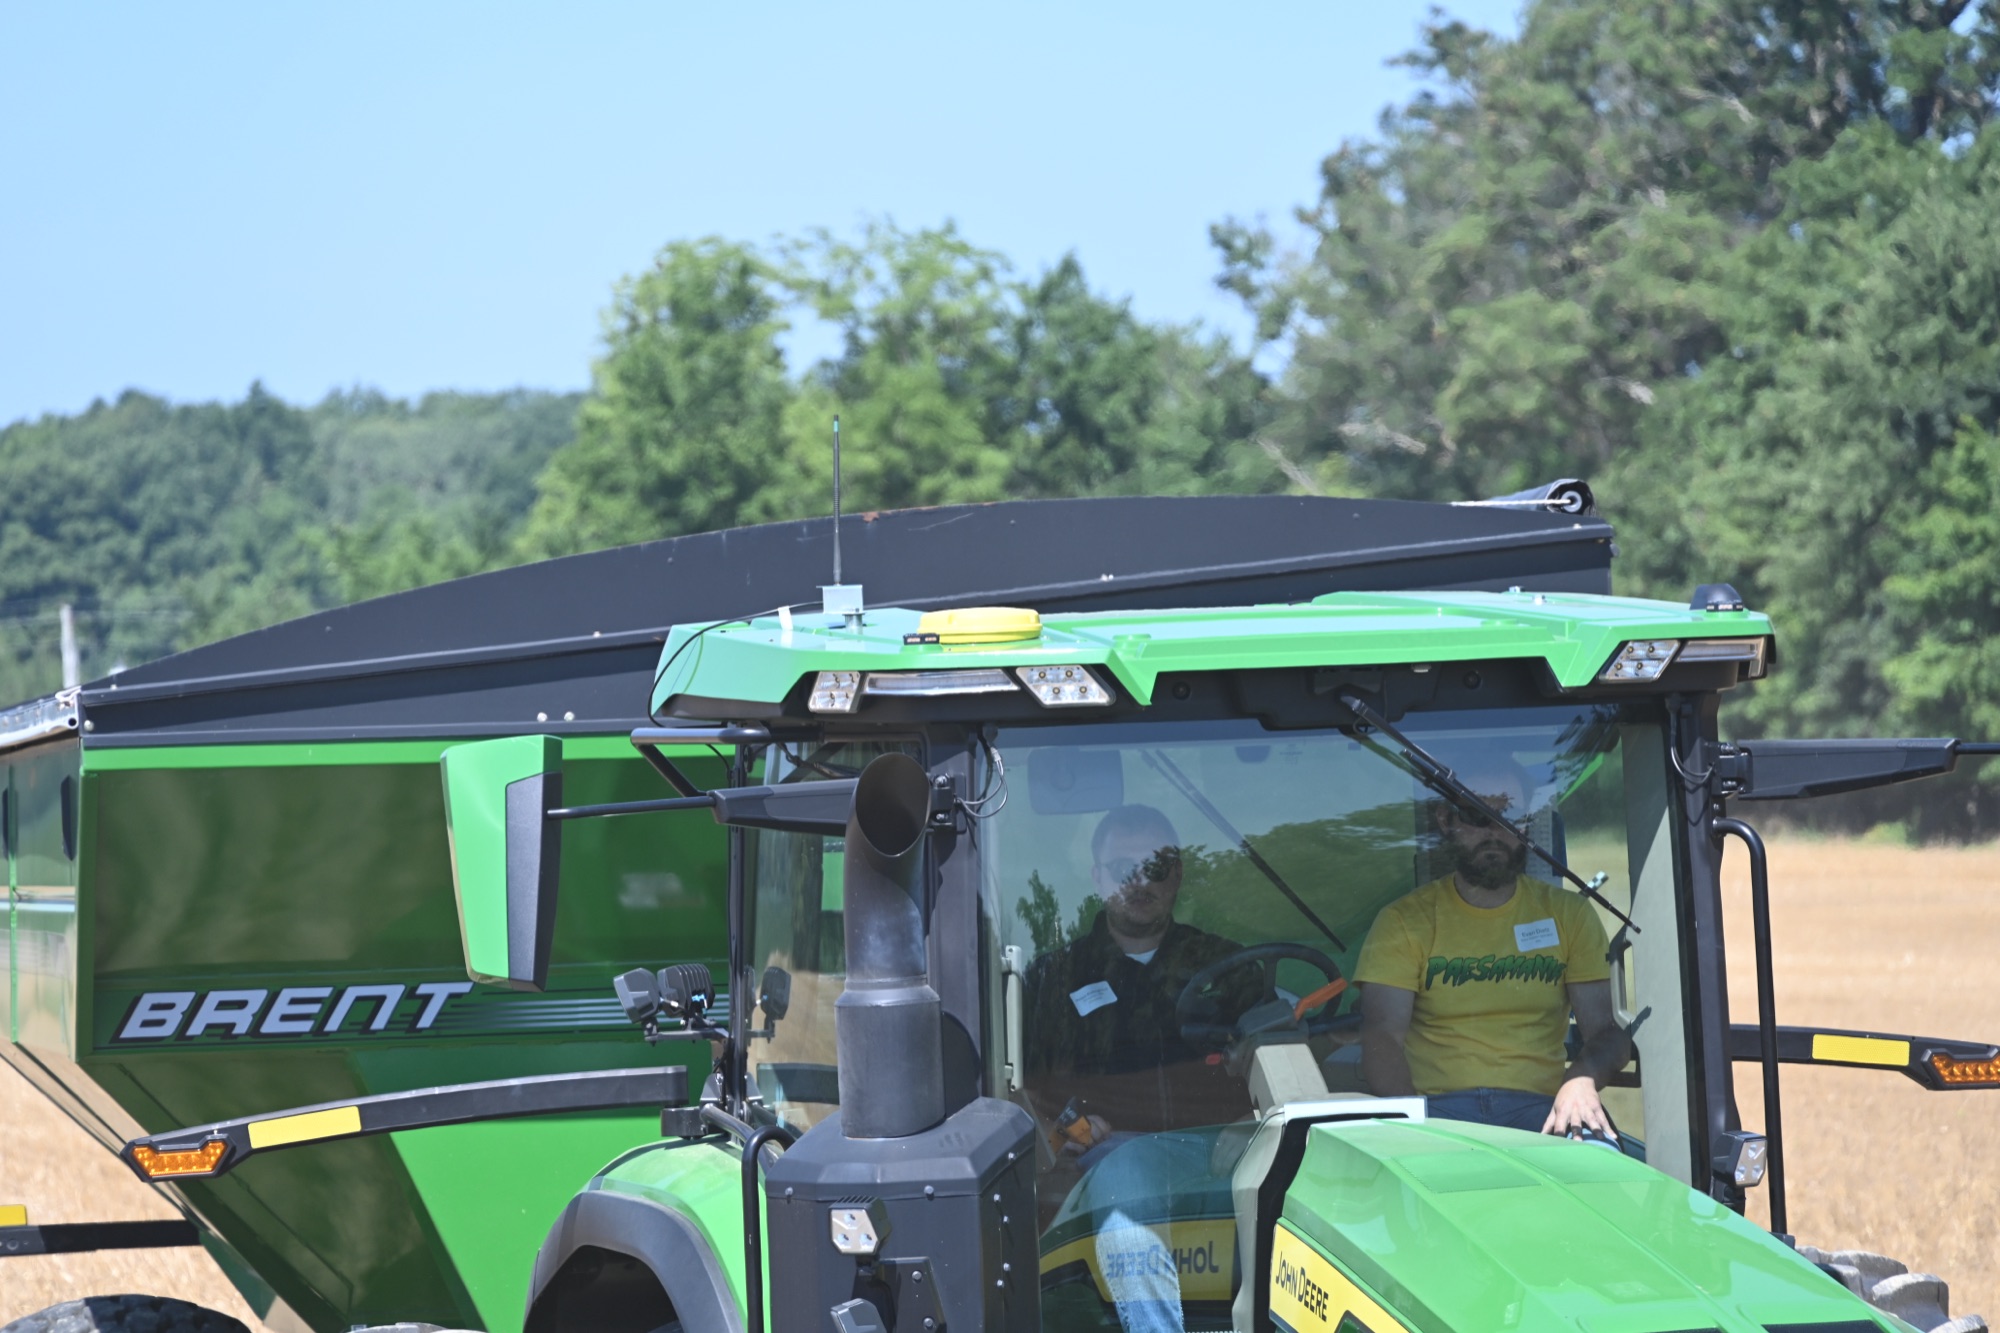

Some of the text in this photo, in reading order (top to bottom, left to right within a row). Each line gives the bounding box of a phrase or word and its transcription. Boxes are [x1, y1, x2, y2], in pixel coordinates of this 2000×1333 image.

[112, 981, 475, 1042] BRENT
[1275, 1250, 1329, 1322] JOHN DEERE
